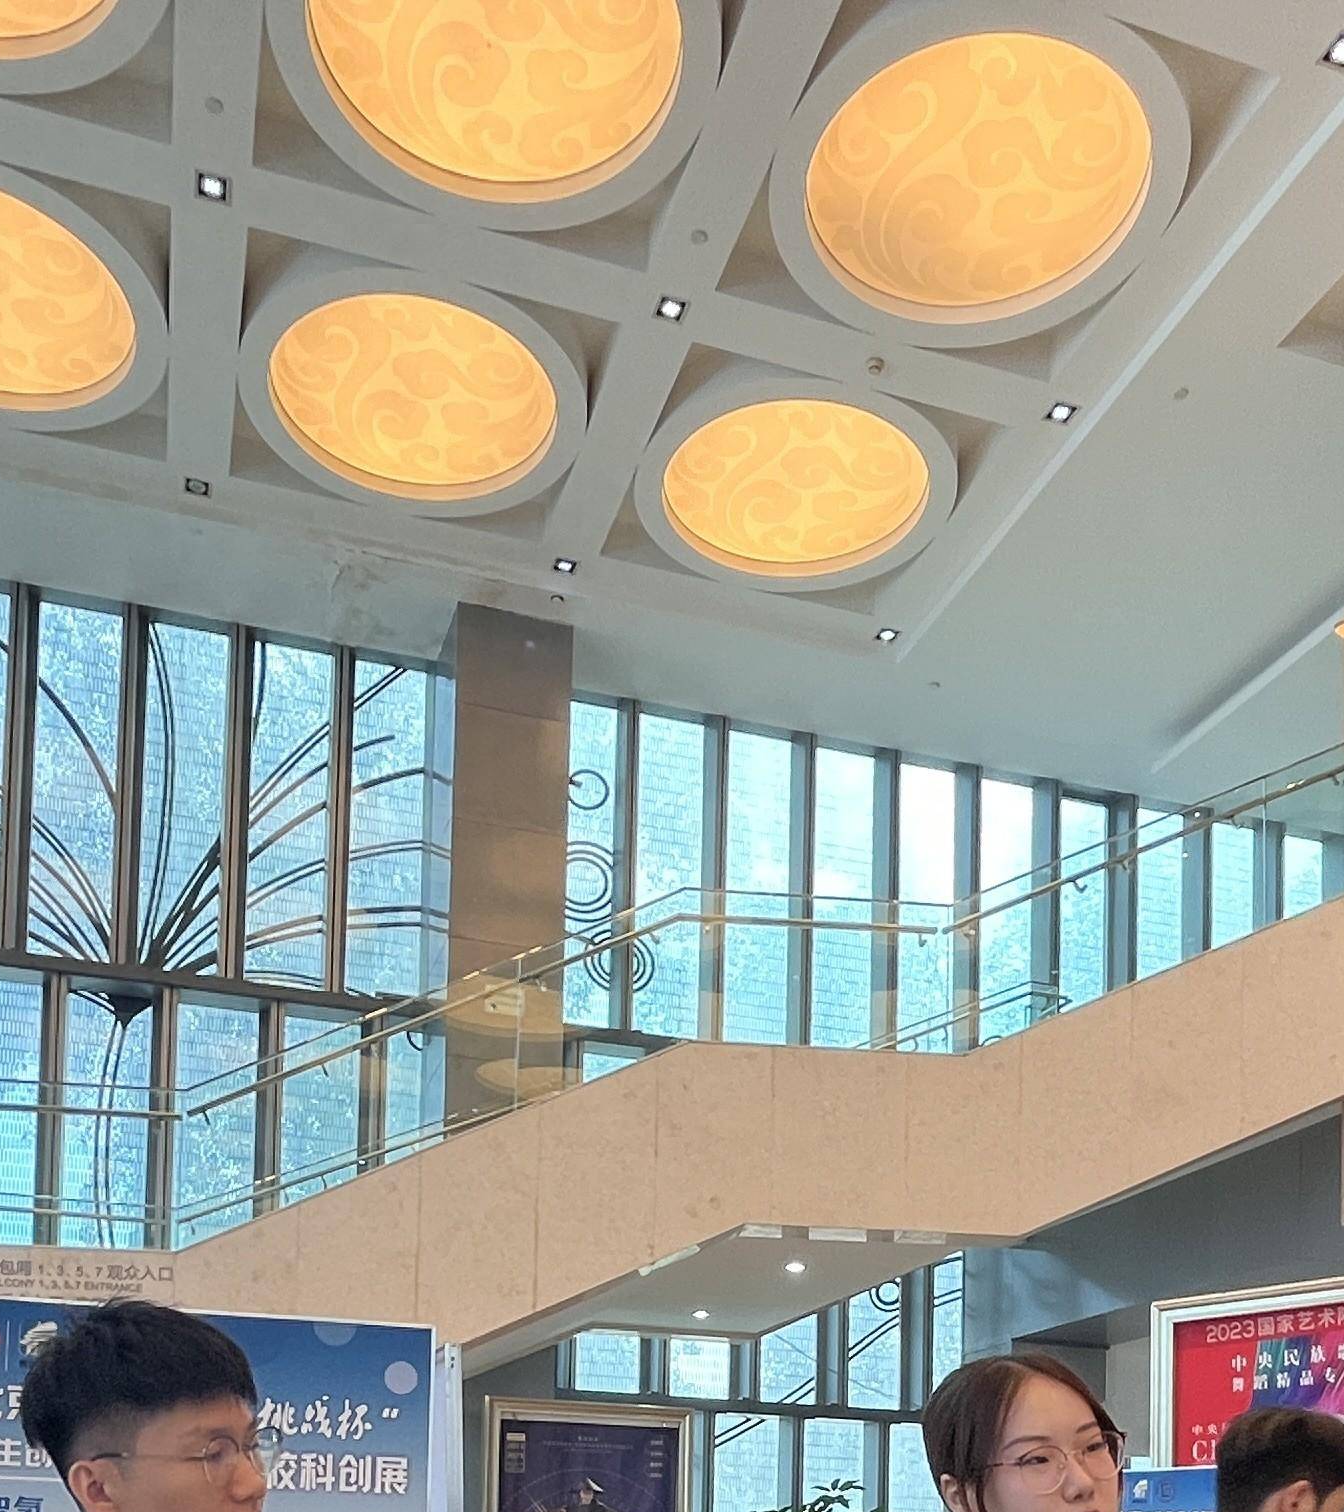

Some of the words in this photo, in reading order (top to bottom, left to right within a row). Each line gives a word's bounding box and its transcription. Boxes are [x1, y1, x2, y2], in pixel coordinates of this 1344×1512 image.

[107, 1264, 175, 1282] 观众入口
[84, 1281, 144, 1294] ENTRANCE
